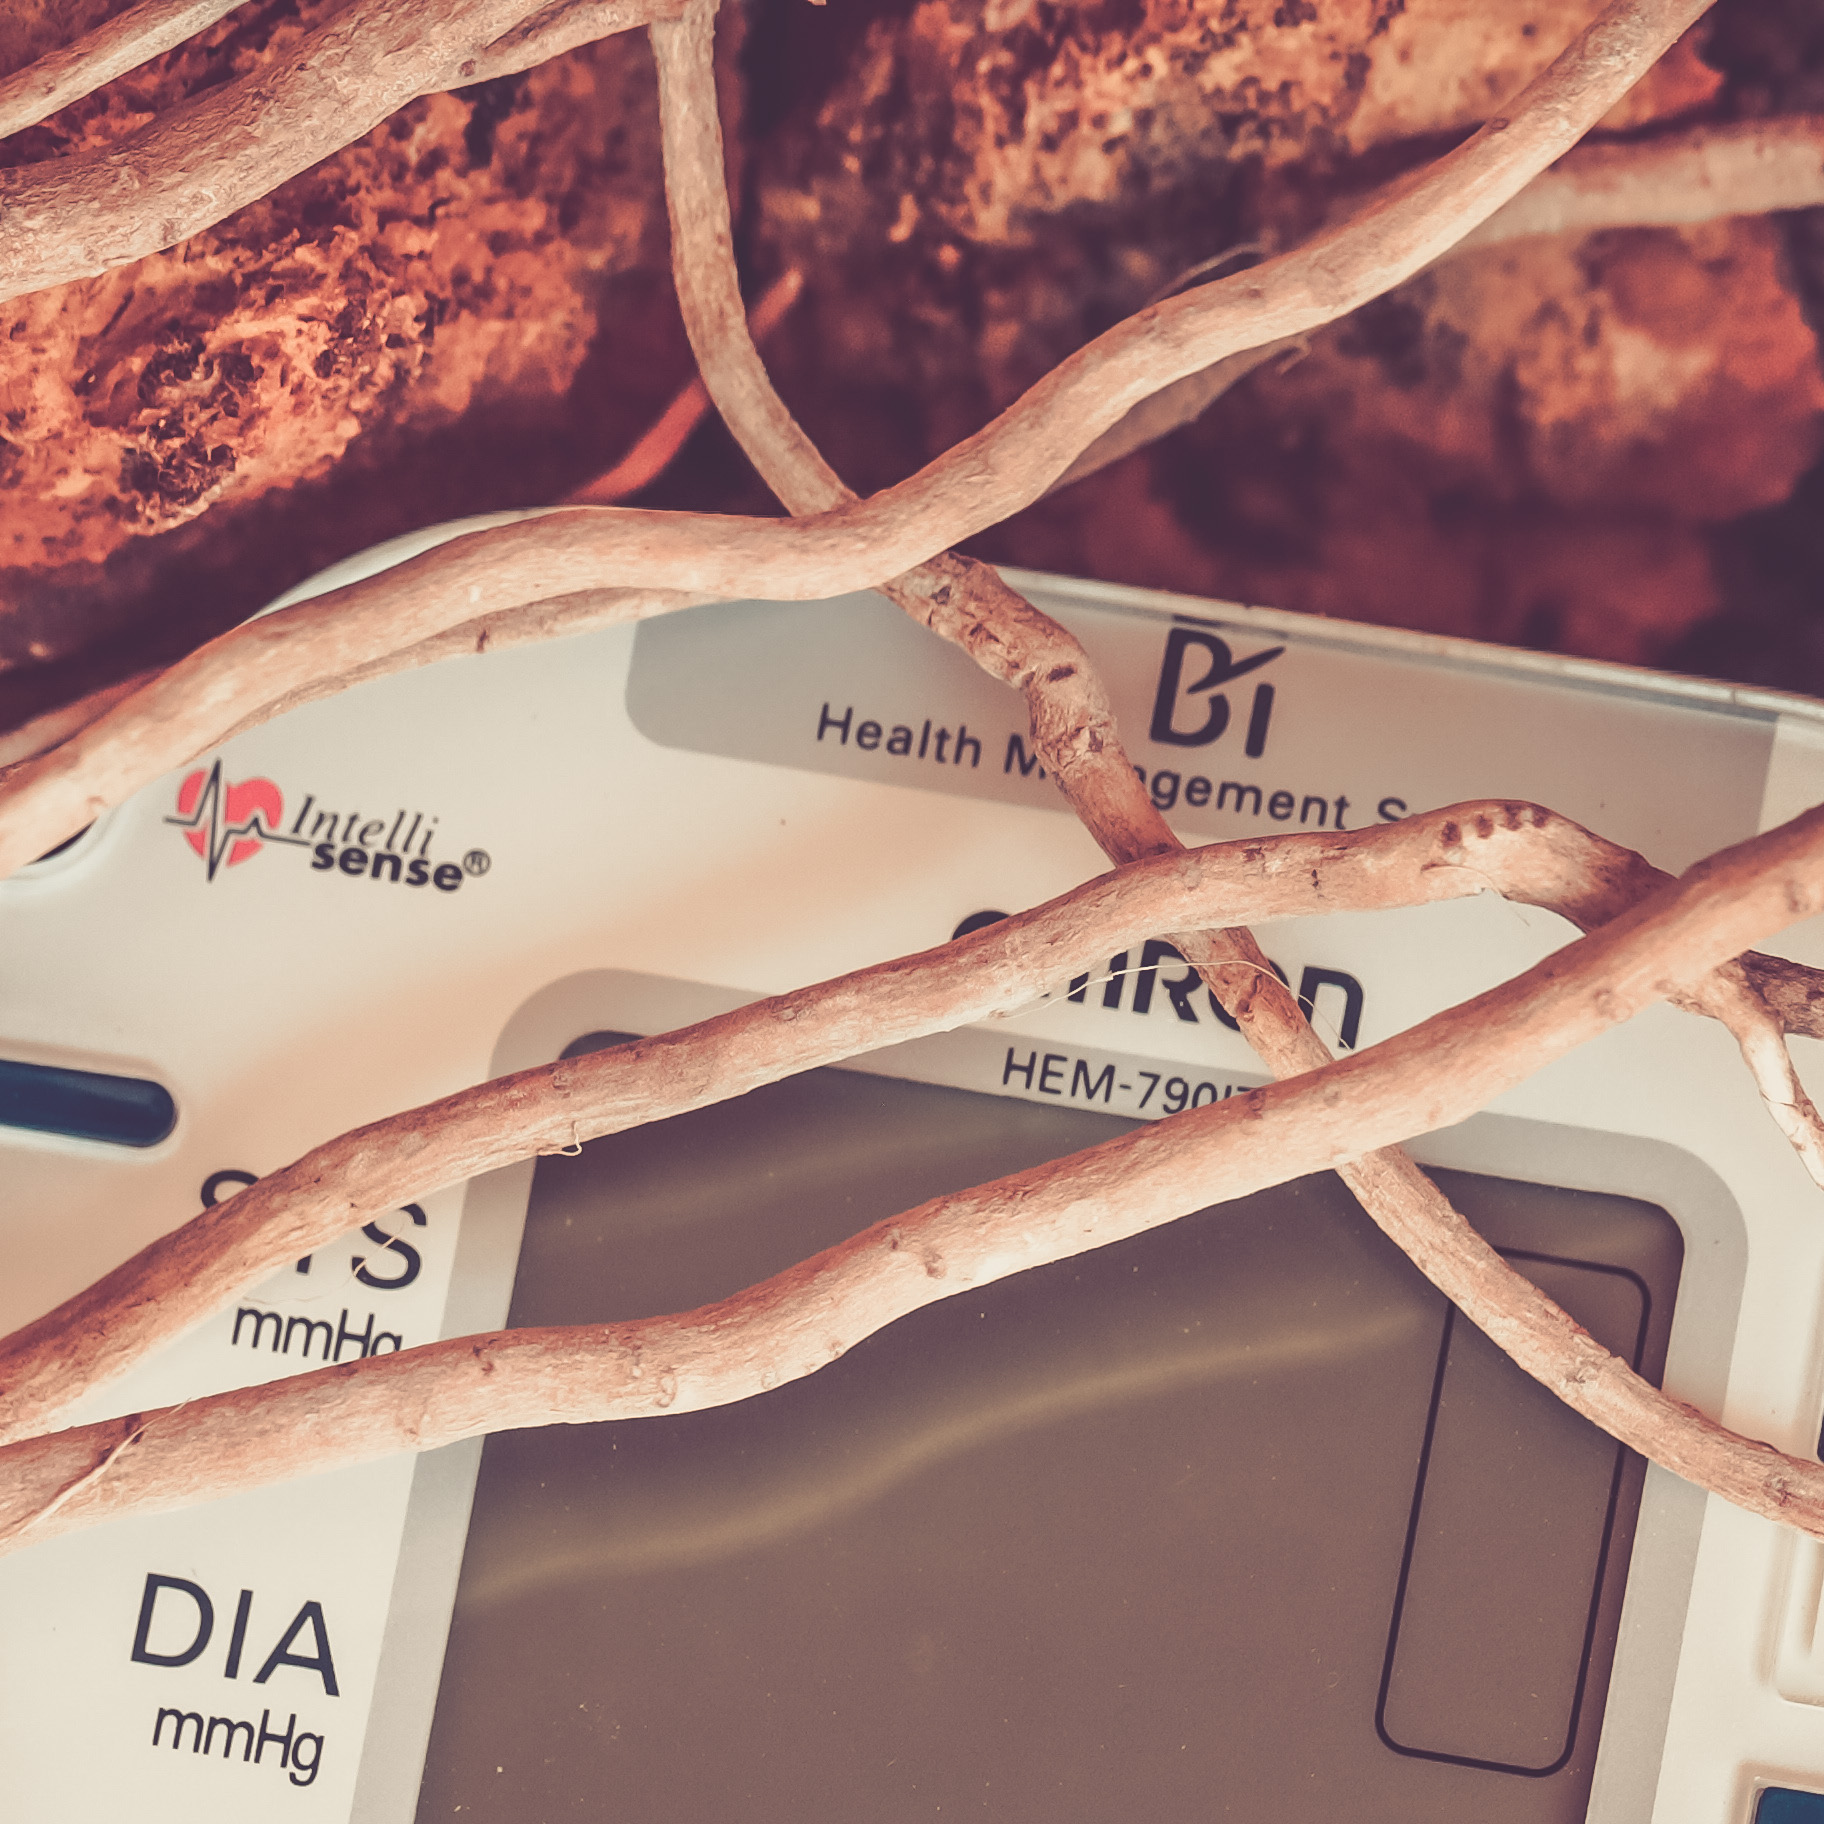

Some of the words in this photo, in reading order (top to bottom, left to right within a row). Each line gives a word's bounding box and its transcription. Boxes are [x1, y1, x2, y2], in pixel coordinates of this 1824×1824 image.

[816, 702, 980, 767] Health
[1003, 732, 1350, 830] Mgement
[289, 794, 438, 856] Intelli
[1002, 1046, 1256, 1114] HEM-790
[130, 1572, 340, 1697] DIA
[152, 1707, 325, 1786] mmHg
